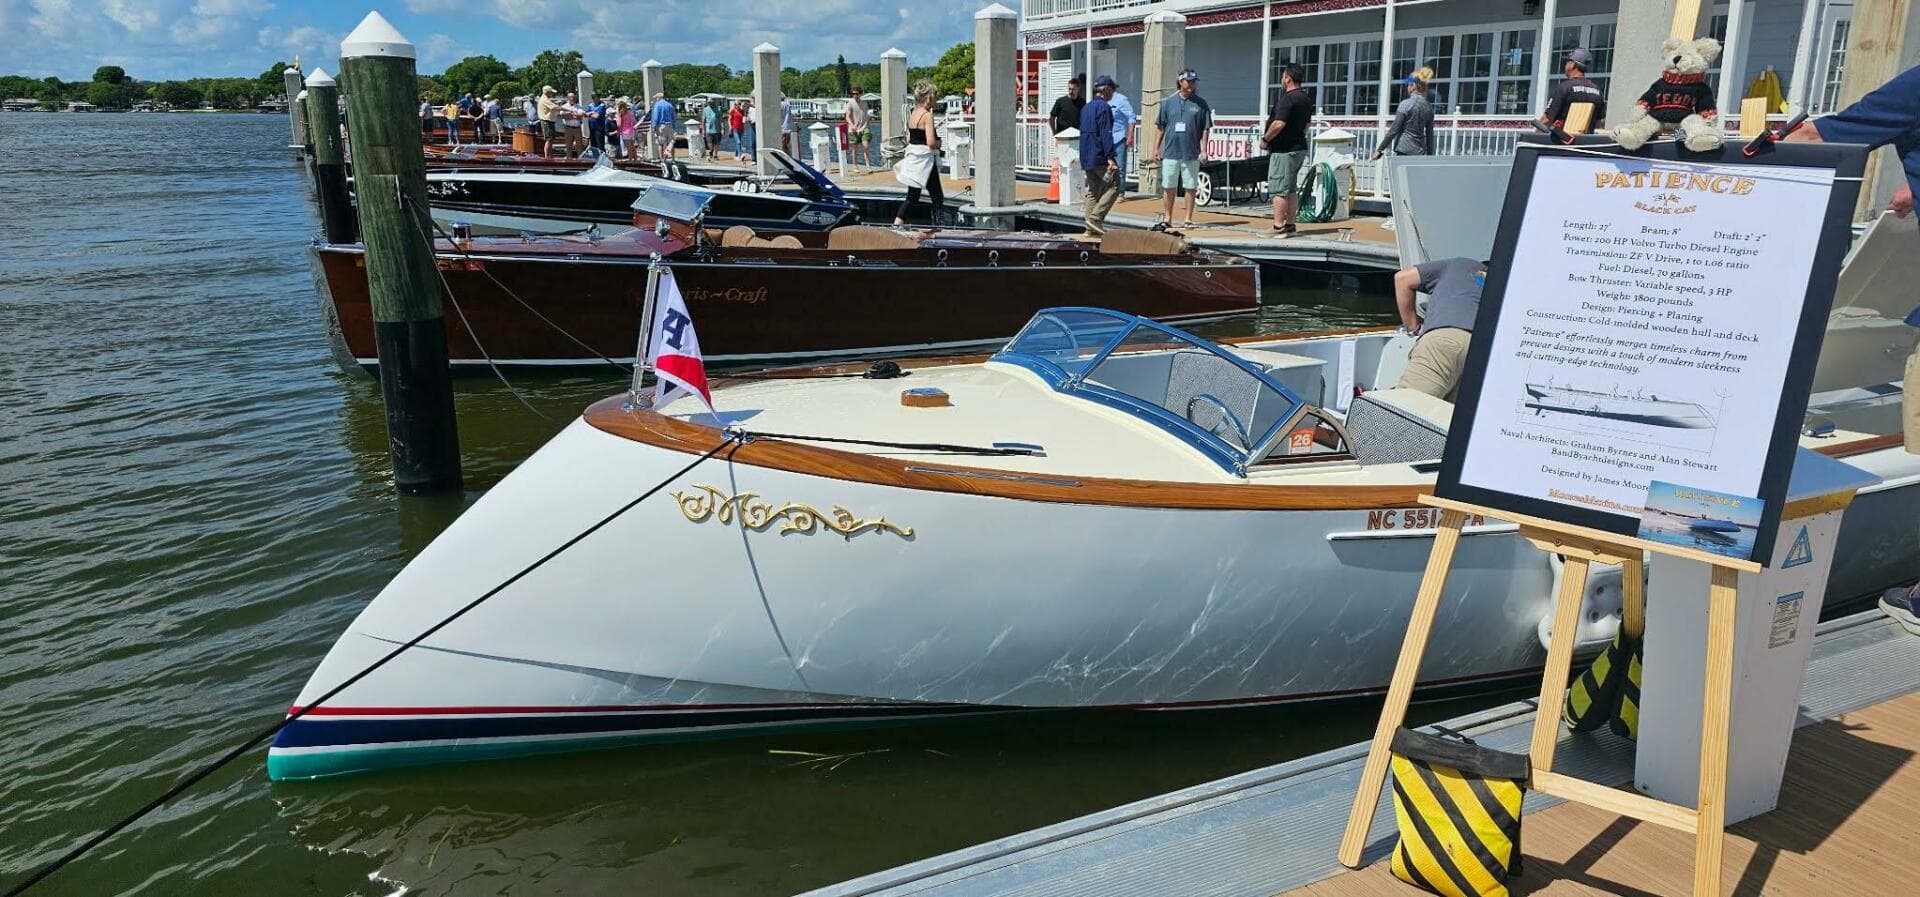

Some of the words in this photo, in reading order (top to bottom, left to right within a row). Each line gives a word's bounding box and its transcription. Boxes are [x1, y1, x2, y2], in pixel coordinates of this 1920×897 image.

[1595, 171, 1756, 195] PATIENCE
[1563, 219, 1597, 231] Length:
[1640, 225, 1670, 236] Beam:
[1713, 230, 1743, 241] Draft:
[1563, 232, 1593, 243] Power:
[1613, 236, 1629, 246] HP
[1630, 238, 1656, 248] Volvo
[1658, 240, 1687, 250] Turbo
[1690, 242, 1721, 254] Diesel
[1723, 245, 1759, 257] Engine
[1566, 246, 1628, 260] Transmission:
[1629, 251, 1644, 261] ZF
[1645, 252, 1653, 261] V
[1654, 253, 1683, 265] Drive,
[1692, 257, 1702, 266] to
[1704, 259, 1723, 268] 1.06
[1725, 260, 1750, 270] ratio
[1598, 262, 1621, 272] Fuel:
[1623, 264, 1655, 276] Diesel,
[1657, 269, 1669, 278] 70
[1669, 268, 1705, 280] gallons
[1568, 273, 1588, 282] Bow
[1589, 274, 1633, 287] Thruster:
[1635, 279, 1673, 292] Variable
[1675, 284, 1706, 295] speed,
[1708, 288, 1714, 297] 3
[1715, 287, 1733, 297] HP
[1597, 289, 1631, 301] Weight:
[1633, 293, 1656, 303] 3800
[1657, 296, 1694, 307] pounds
[1581, 301, 1615, 313] Design:
[1618, 305, 1656, 319] Piercing
[1666, 310, 1704, 324] Planing
[1526, 308, 1587, 323] Construction:
[1588, 316, 1649, 330] Cold-molded
[1651, 324, 1689, 335] wooden
[1691, 327, 1712, 338] hull
[1713, 331, 1733, 340] and
[1735, 332, 1759, 343] deck
[1519, 338, 1552, 349] prewar
[1553, 342, 1586, 354] designs
[1587, 347, 1609, 357] with
[1618, 351, 1645, 361] touch
[1646, 354, 1657, 364] of
[1658, 356, 1694, 368] modern
[1696, 361, 1741, 374] sleekness
[1565, 332, 1614, 346] effortlessly
[1615, 340, 1648, 350] merges
[1650, 342, 1688, 354] timeless
[1689, 346, 1721, 358] charm
[1721, 350, 1748, 361] from
[1515, 350, 1533, 359] and
[1533, 353, 1588, 367] cutting-edge
[1589, 360, 1641, 375] technology.
[1294, 433, 1311, 447] 26
[1500, 428, 1523, 439] Naval
[1524, 432, 1569, 446] Architects:
[1570, 440, 1605, 453] Graham
[1607, 446, 1638, 458] Byrnes
[1639, 452, 1657, 461] and
[1659, 455, 1680, 465] Alan
[1682, 458, 1718, 472] Stewart
[1551, 447, 1655, 472] BandByachtdesigns.com
[1541, 464, 1581, 479] Designed
[1581, 471, 1593, 481] by
[1594, 474, 1621, 486] James
[1367, 510, 1398, 530] NC
[1403, 509, 1444, 528] 551
